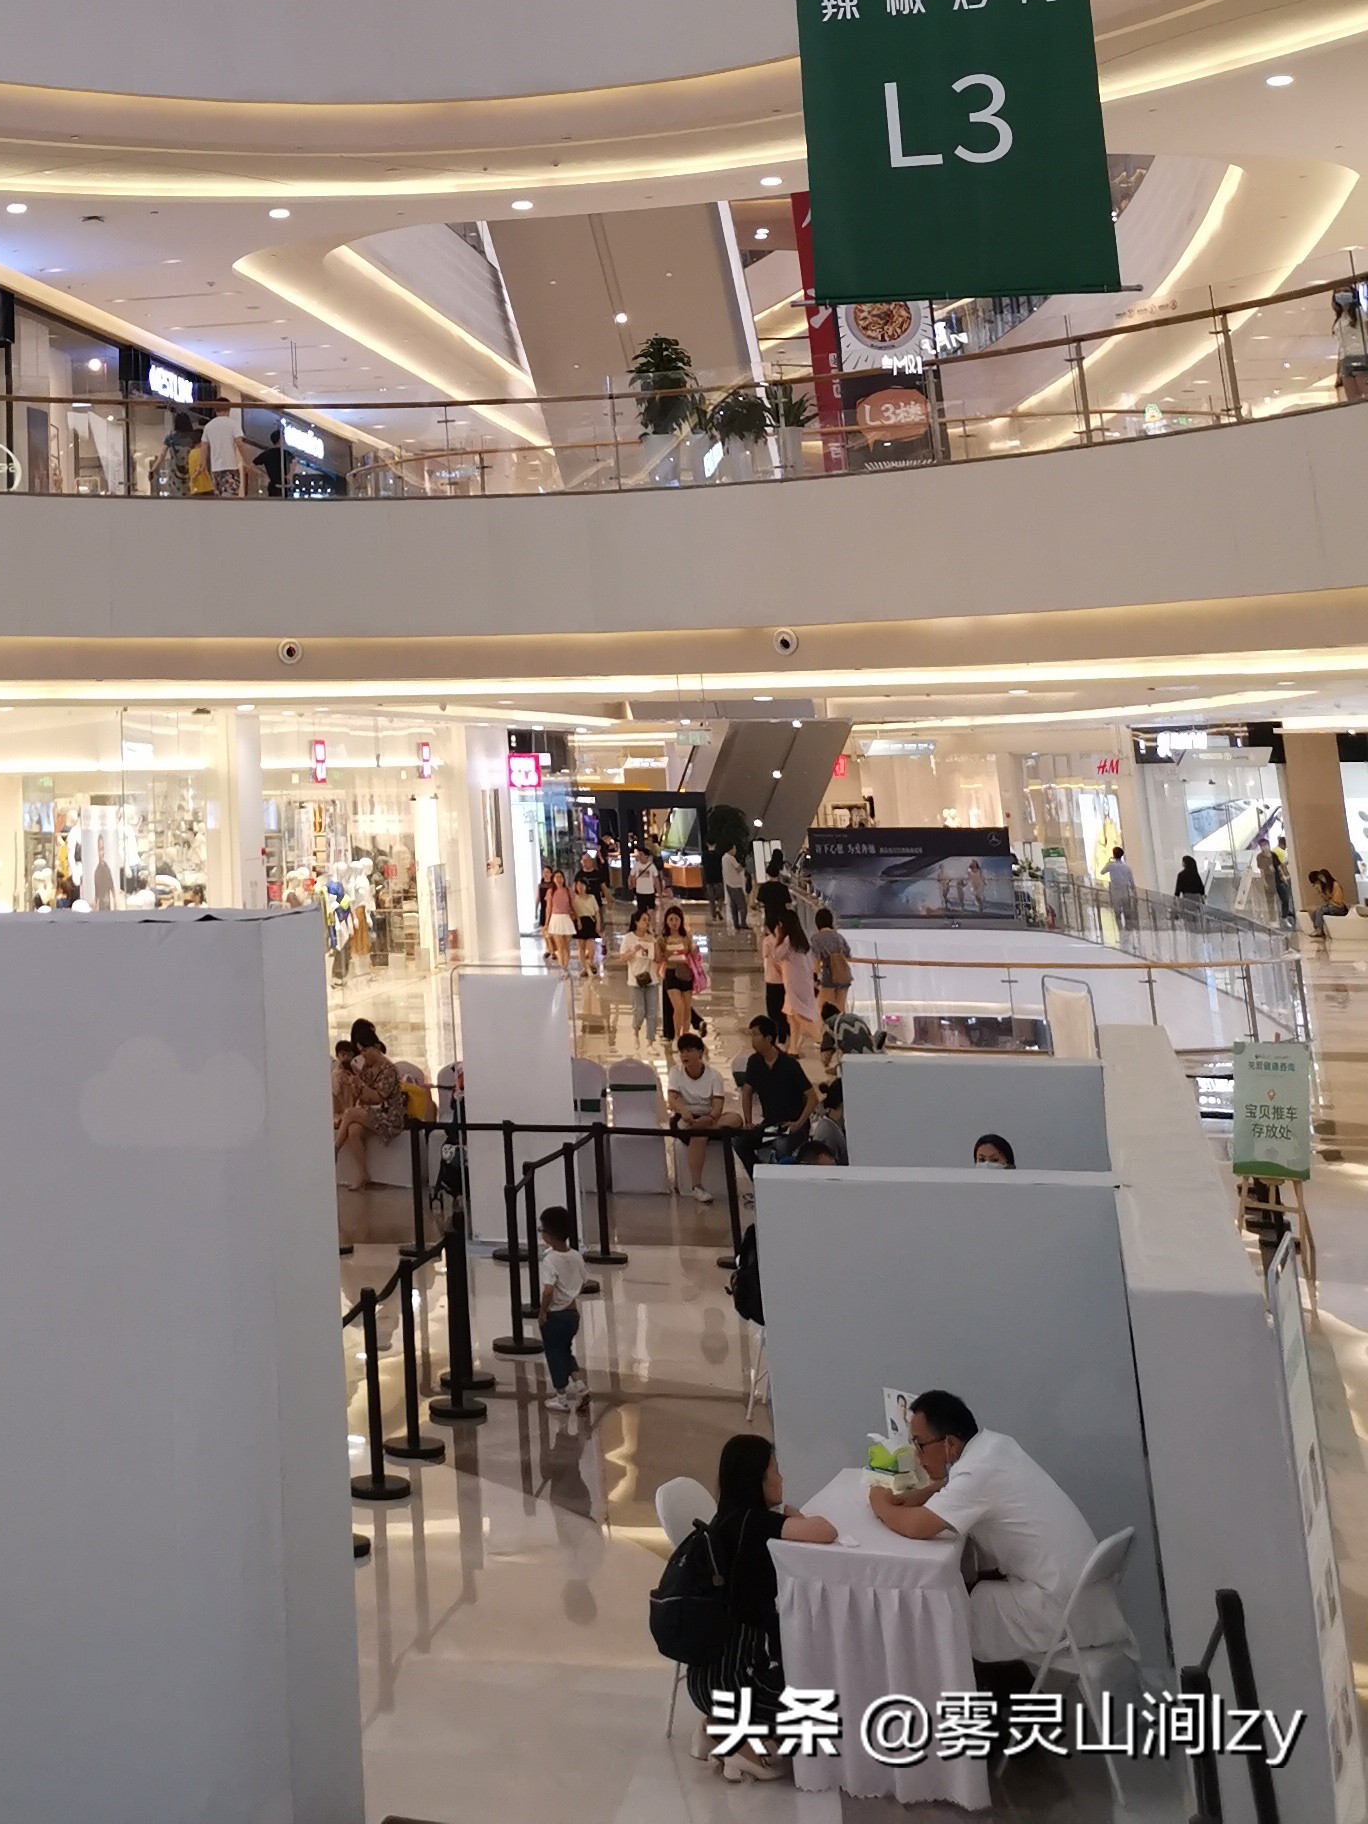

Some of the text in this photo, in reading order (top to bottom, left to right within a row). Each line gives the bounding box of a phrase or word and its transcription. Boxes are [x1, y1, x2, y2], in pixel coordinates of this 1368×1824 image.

[884, 73, 1014, 169] L3
[1245, 1104, 1299, 1122] 宝贝推车
[1251, 1122, 1292, 1140] 存放处
